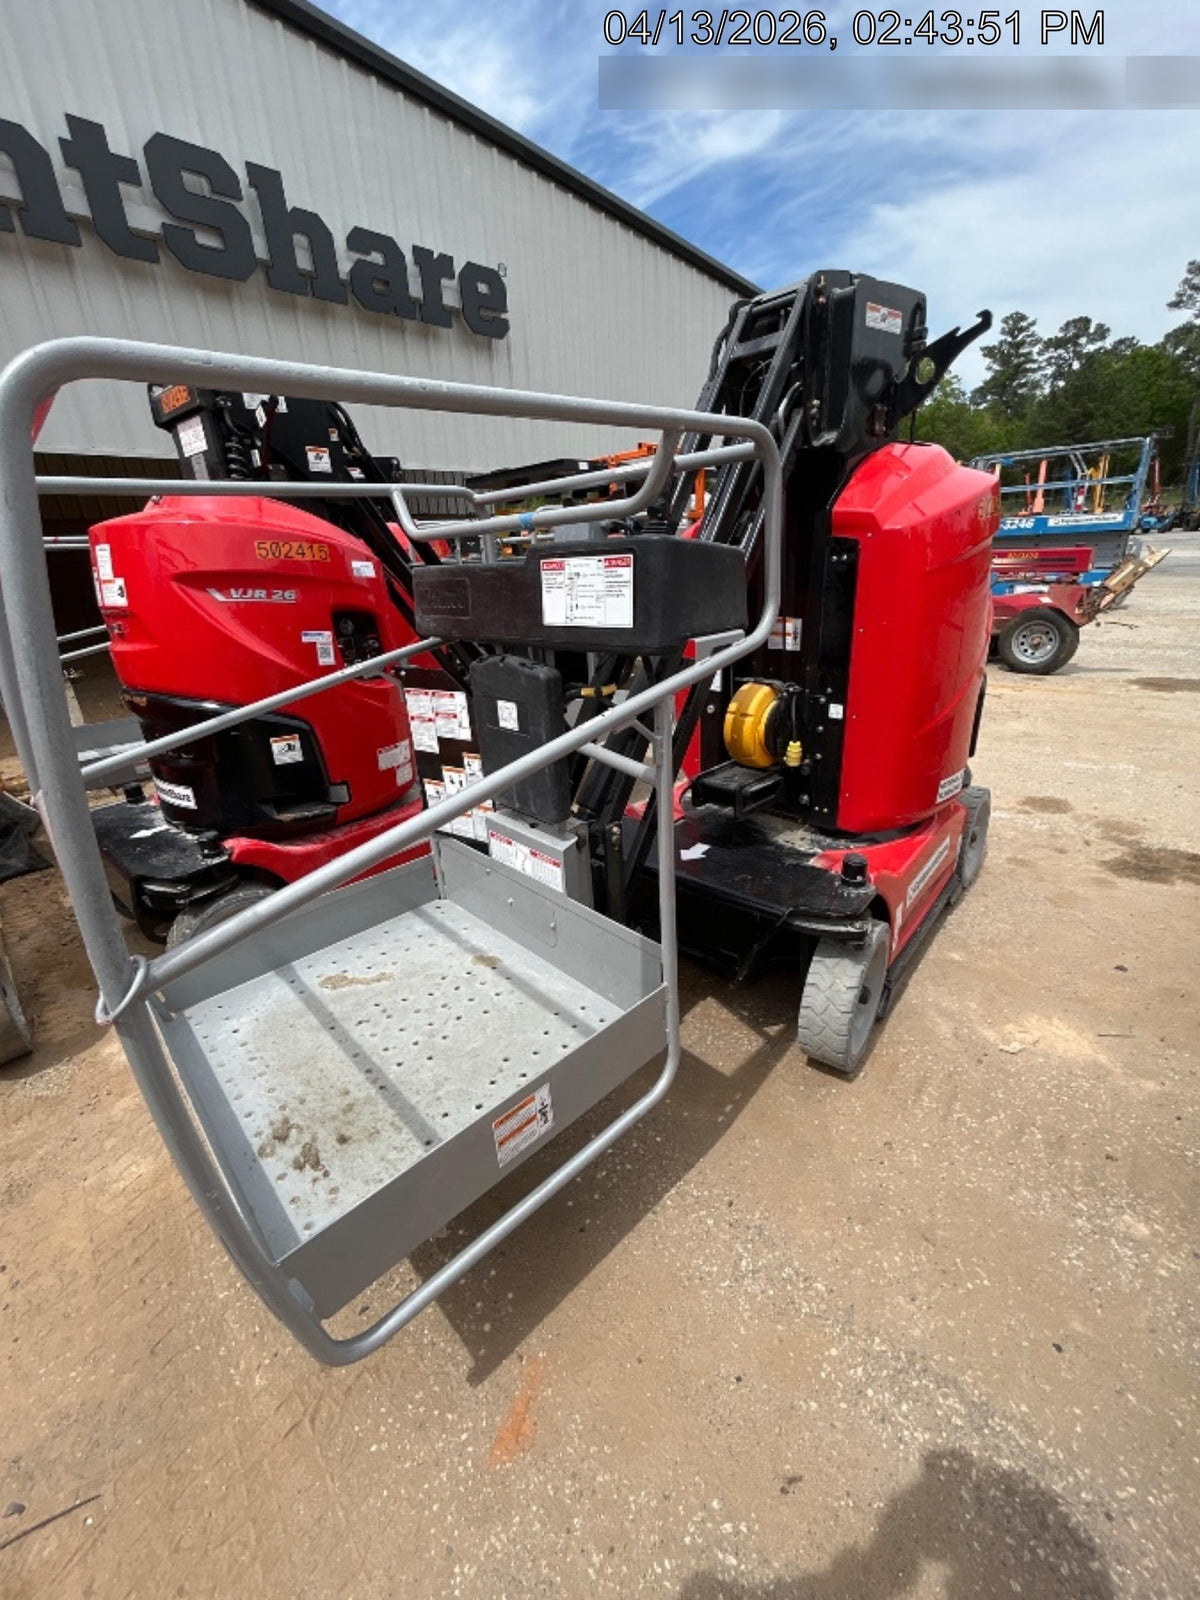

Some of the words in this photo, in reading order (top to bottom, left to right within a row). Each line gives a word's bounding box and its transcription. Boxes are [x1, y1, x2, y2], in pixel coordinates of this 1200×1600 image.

[256, 541, 329, 561] 502415
[229, 588, 268, 600] VJR
[270, 589, 297, 601] 26
